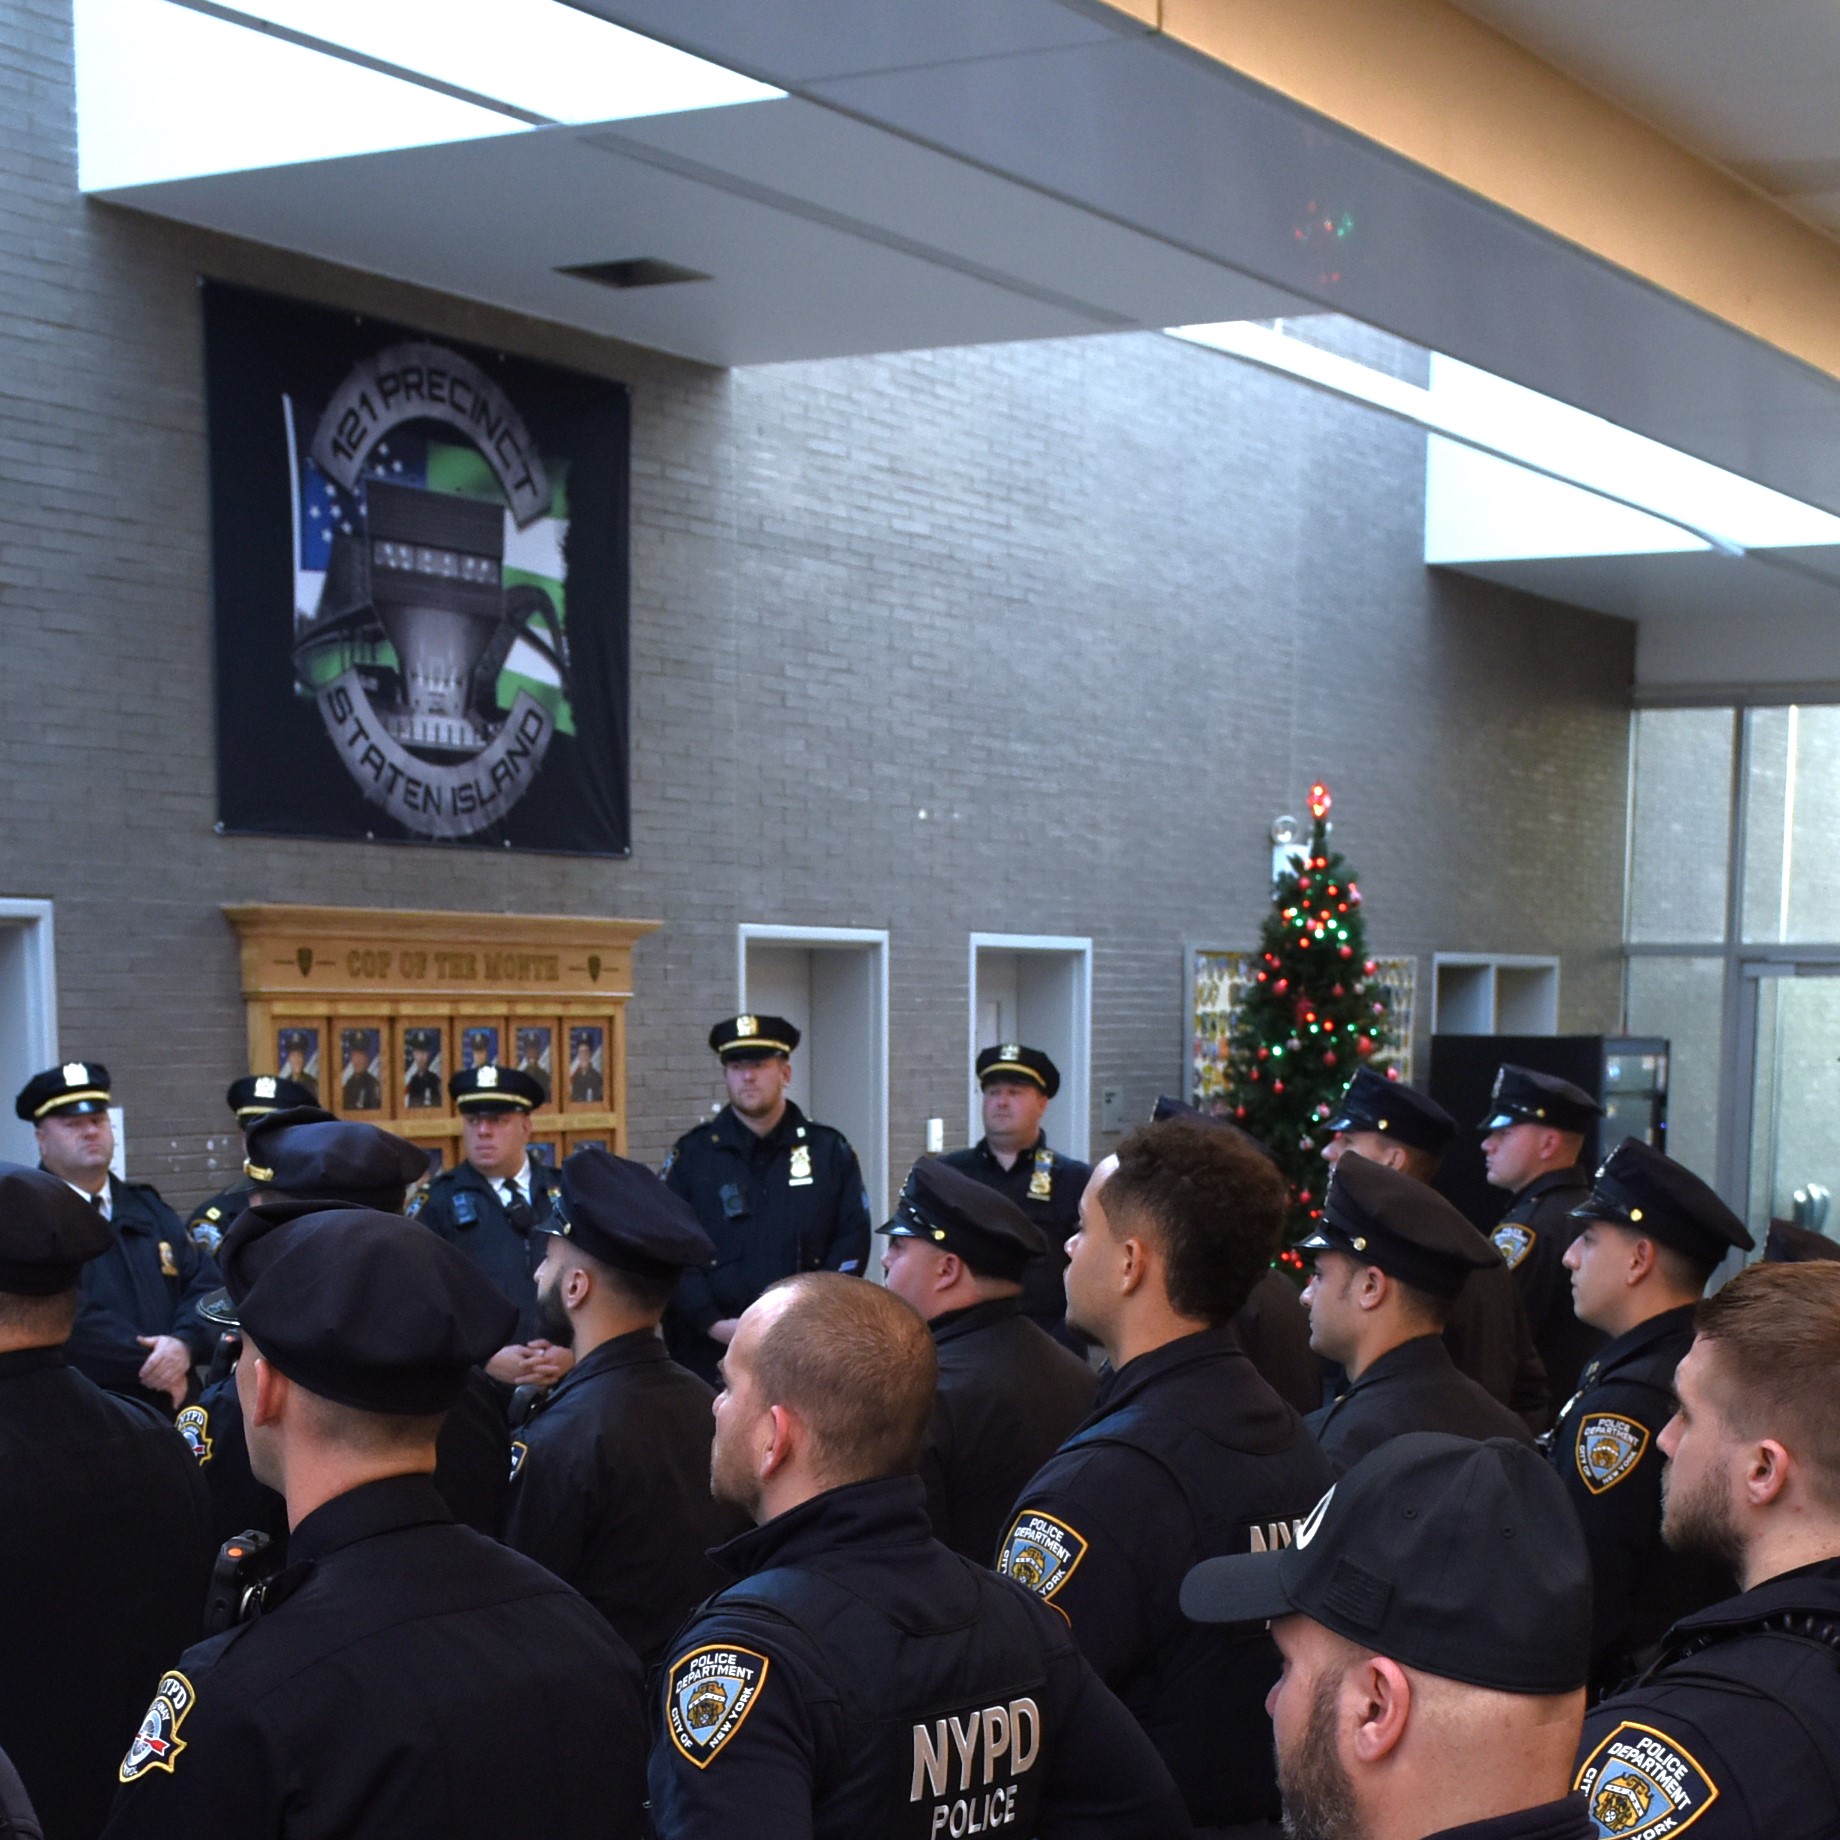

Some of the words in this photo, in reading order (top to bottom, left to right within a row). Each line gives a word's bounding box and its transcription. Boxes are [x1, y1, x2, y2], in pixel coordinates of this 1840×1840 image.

[330, 390, 382, 462] 121
[375, 363, 537, 500] PRECINCT
[326, 685, 443, 816] STATEN
[450, 705, 546, 815] ISLAND
[346, 949, 392, 980] COP
[399, 950, 429, 980] OF
[434, 951, 478, 981] THE
[484, 952, 560, 983] MONTH
[1584, 1426, 1640, 1446] DEPARTMENT
[1598, 1418, 1631, 1433] POLICE
[1013, 1526, 1072, 1564] DEPARTMENT
[1029, 1517, 1065, 1542] POLICE
[1039, 1569, 1066, 1596] YORK
[675, 1664, 755, 1695] DEPARTMENT
[689, 1653, 737, 1672] POLICE
[671, 1707, 684, 1734] CITY
[679, 1734, 694, 1749] OF
[709, 1722, 732, 1749] NEW
[728, 1686, 755, 1720] YORK
[909, 1697, 1041, 1802] NYPD
[1637, 1736, 1689, 1781] POLICE
[1580, 1767, 1598, 1797] CIT
[1607, 1742, 1692, 1811] DEPARTMENT
